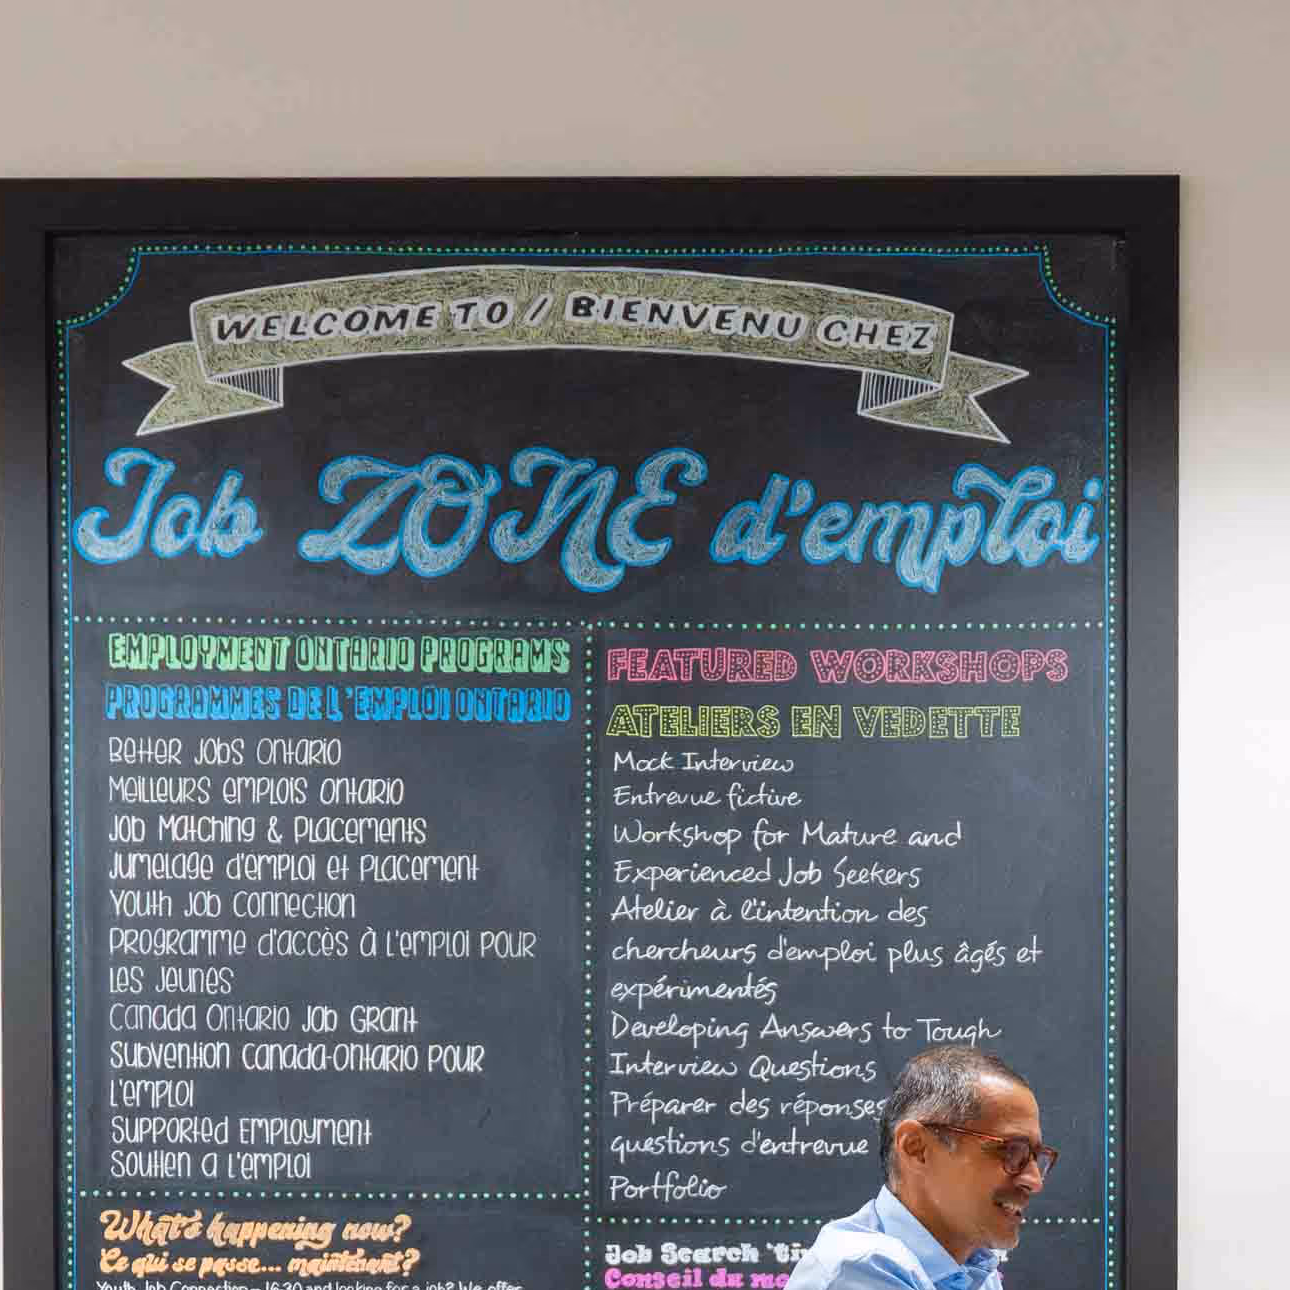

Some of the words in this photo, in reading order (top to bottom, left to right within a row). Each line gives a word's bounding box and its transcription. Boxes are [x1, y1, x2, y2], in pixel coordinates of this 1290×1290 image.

[214, 304, 438, 346] WELCOME
[454, 297, 509, 328] TO
[527, 295, 548, 327] /
[570, 295, 803, 342] BIENVENU
[823, 319, 938, 355] CHEZ
[72, 446, 266, 567] Job
[297, 446, 710, 594] ZONE
[710, 464, 1105, 595] d'emploi
[108, 633, 291, 672] EMPLOYMENT
[296, 636, 415, 672] ONTARIO
[420, 636, 571, 673] PROGRAMS
[606, 648, 798, 683] FEATURED
[810, 648, 1070, 683] WORKSHOPS
[105, 683, 281, 721] PROGRAMMES
[286, 685, 325, 721] DE
[455, 687, 571, 723] ONTARIO
[606, 704, 780, 738] ATELIERS
[791, 704, 842, 738] EN
[853, 704, 1022, 738] VEDETTE
[613, 750, 675, 772] Mock
[681, 747, 794, 773] Interview
[612, 781, 722, 806] Entrevue
[726, 781, 803, 811] fictive
[267, 815, 283, 844] &
[613, 818, 742, 856] Workshop
[752, 817, 790, 852] for
[802, 820, 897, 847] Mature
[908, 820, 962, 847] and
[614, 856, 772, 892] Experienced
[778, 856, 822, 887] Job
[833, 855, 922, 889] Seekers
[610, 893, 700, 922] Atelier
[710, 898, 733, 921] à
[740, 895, 879, 924] l'intention
[887, 897, 929, 928] des
[611, 936, 757, 965] chercheurs
[767, 934, 877, 972] d'emploi
[887, 939, 944, 974] plus
[953, 939, 1006, 974] âgés
[1016, 935, 1043, 963] et
[610, 971, 778, 1010] expérimentés
[611, 1009, 750, 1049] Developing
[759, 1012, 873, 1044] Answers
[881, 1011, 912, 1040] to
[916, 1017, 1002, 1055] Tough
[609, 1049, 738, 1076] Interview
[748, 1049, 877, 1083] Questions
[609, 1090, 717, 1125] Préparer
[729, 1087, 771, 1120] des
[610, 1128, 730, 1164] questions
[740, 1126, 869, 1156] d'entrevue
[609, 1170, 728, 1203] Portfolio
[101, 1208, 204, 1247] What's
[207, 1212, 337, 1250] happening
[342, 1214, 412, 1243] now?
[100, 1248, 130, 1273] Ce
[132, 1252, 169, 1278] qui
[172, 1256, 196, 1273] se
[605, 1244, 653, 1265] Job
[661, 1242, 760, 1265] Search
[604, 1268, 703, 1289] Conseil
[709, 1268, 744, 1289] du
